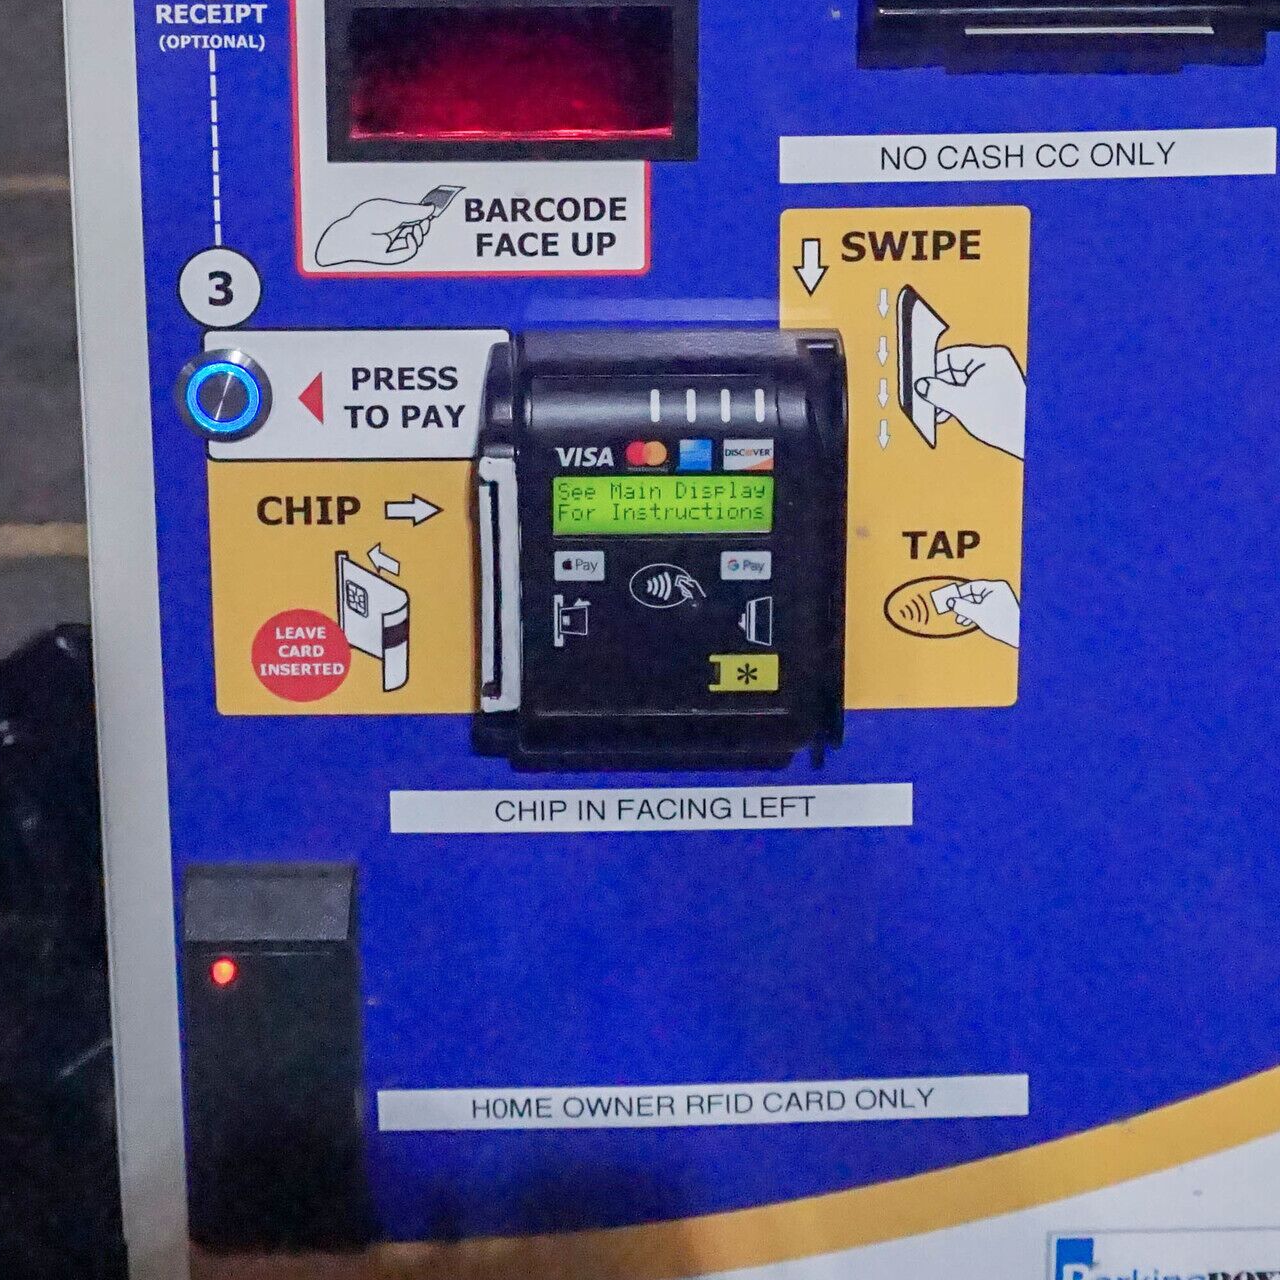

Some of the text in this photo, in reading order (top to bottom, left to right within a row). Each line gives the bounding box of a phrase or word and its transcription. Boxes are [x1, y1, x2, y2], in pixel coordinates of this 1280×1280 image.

[156, 4, 268, 24] RECEIPT
[159, 34, 265, 52] (OPTIONAL)
[881, 142, 1175, 170] NO CASH CC ONLY
[465, 197, 626, 222] BARCODE
[477, 232, 616, 257] FACE UP
[841, 230, 981, 262] SWIPE
[209, 271, 233, 306] 3
[352, 366, 458, 391] PRESS
[344, 405, 465, 429] TO PAY
[555, 447, 614, 467] VISA
[558, 481, 765, 501] See Main Display
[257, 496, 361, 525] CHIP
[558, 502, 765, 521] For Instructions
[902, 530, 980, 560] TAP
[575, 558, 598, 574] Pay
[743, 559, 765, 574] Pay
[276, 626, 326, 639] LEAVE
[278, 645, 324, 658] CARD
[260, 663, 345, 676] INSERTED
[495, 796, 816, 822] CHIP IN FACING LEFT
[563, 1096, 674, 1118] OWNER
[687, 1093, 753, 1115] RFID
[763, 1090, 846, 1113] CARD
[855, 1088, 934, 1110] ONLY
